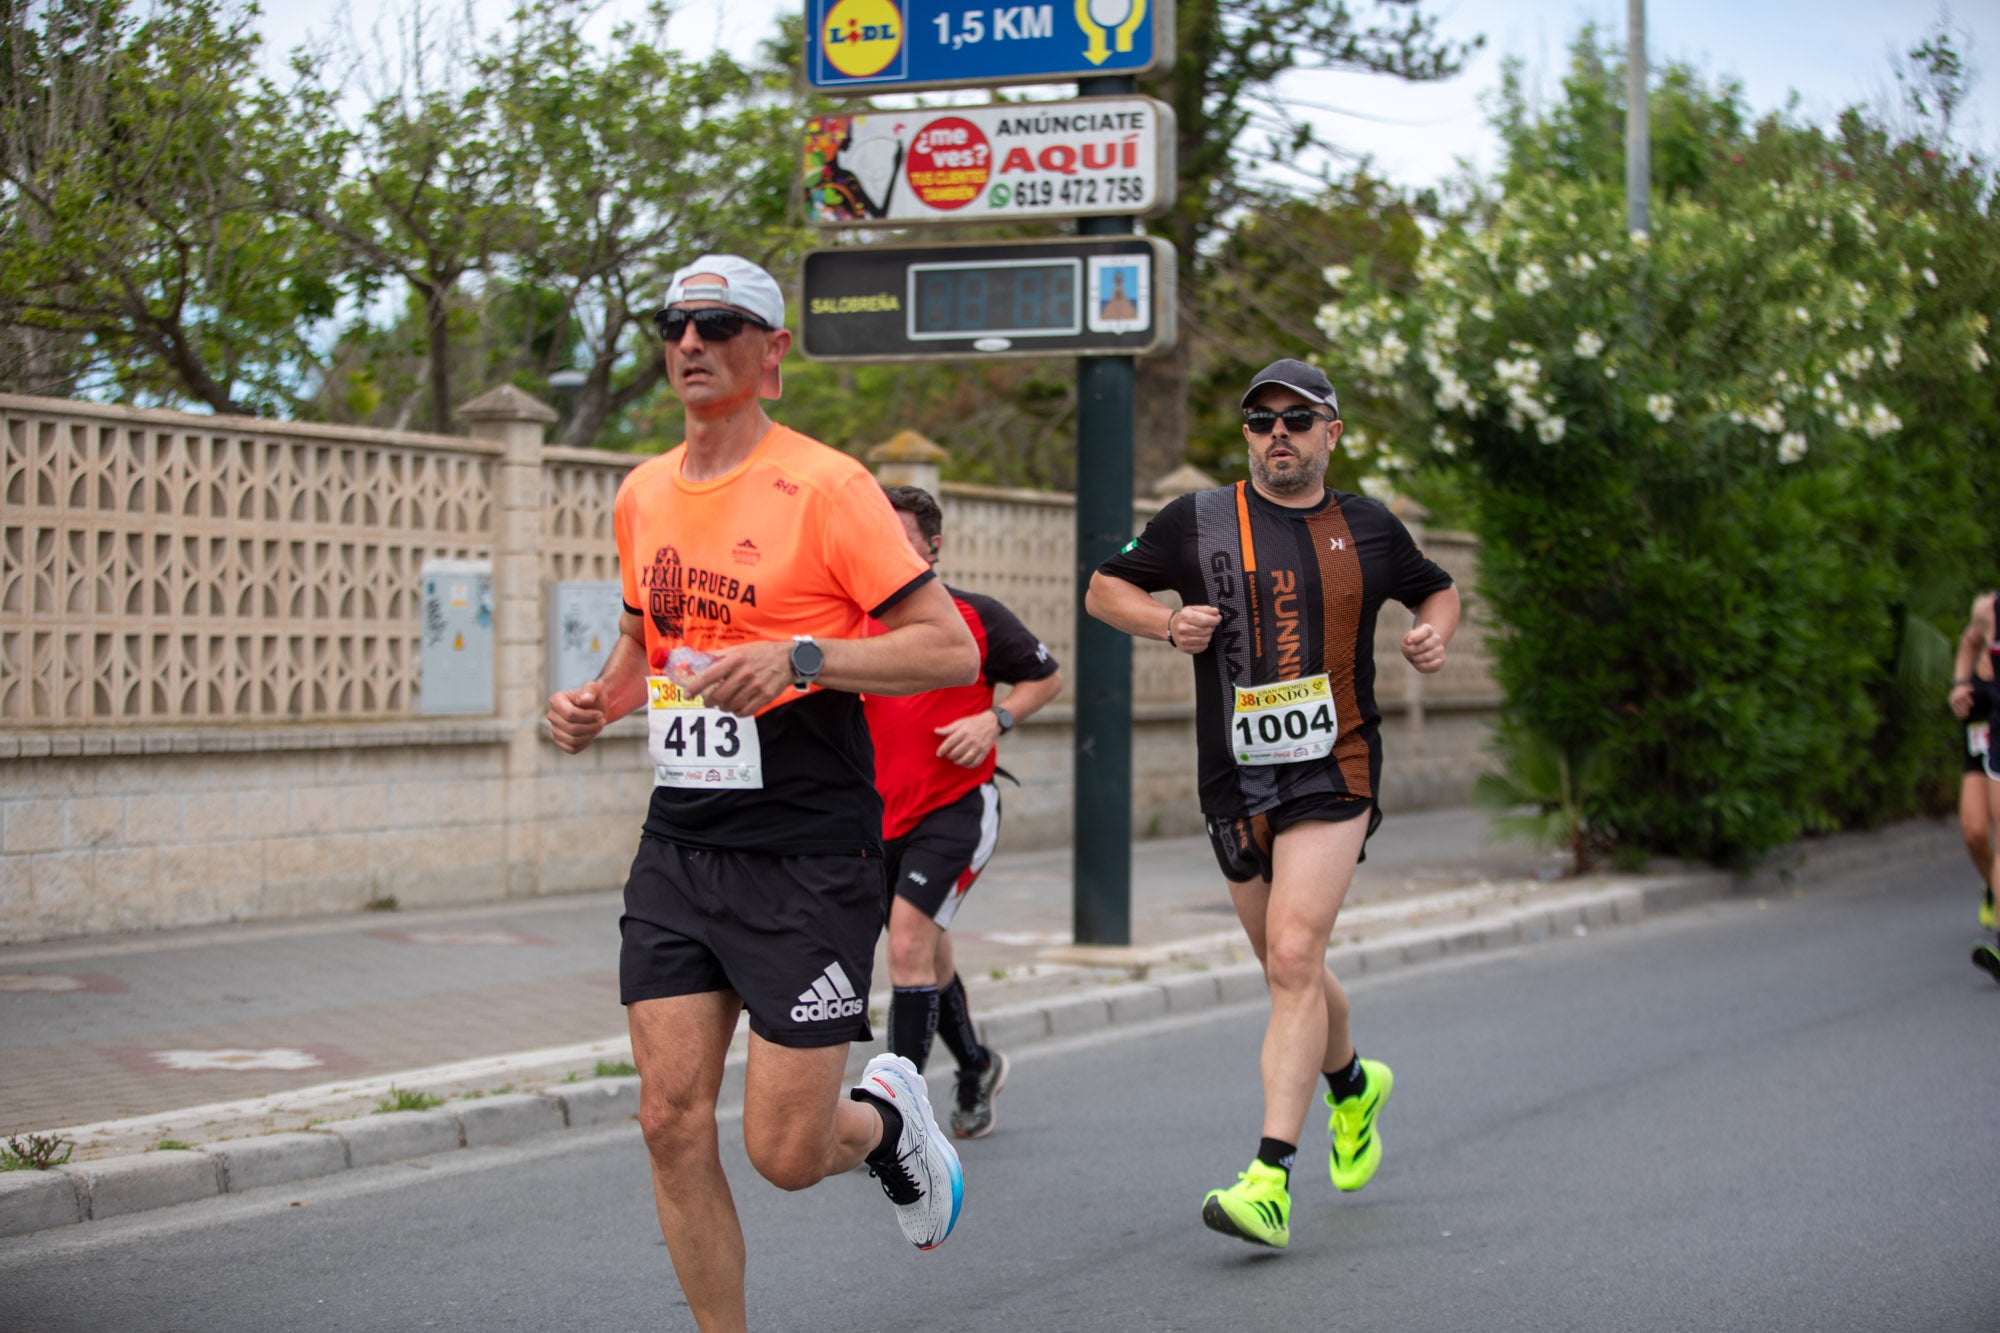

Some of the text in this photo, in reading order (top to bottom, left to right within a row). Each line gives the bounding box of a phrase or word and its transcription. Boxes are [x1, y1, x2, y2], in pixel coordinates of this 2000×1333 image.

[932, 4, 1054, 50] 1,5 KM
[997, 112, 1145, 136] ANÚNCIATE
[915, 127, 969, 155] ¿me
[999, 133, 1140, 176] AQUÍ
[931, 143, 989, 168] ves?
[1015, 177, 1143, 206] 619 472 758
[810, 292, 899, 314] SALOBREÑA
[688, 568, 757, 607] PRUEBA
[679, 594, 731, 625] FONDO
[662, 684, 677, 702] 38
[1240, 694, 1257, 707] 38
[664, 716, 741, 758] 413
[1236, 704, 1334, 746] 1004
[790, 998, 863, 1022] adidas
